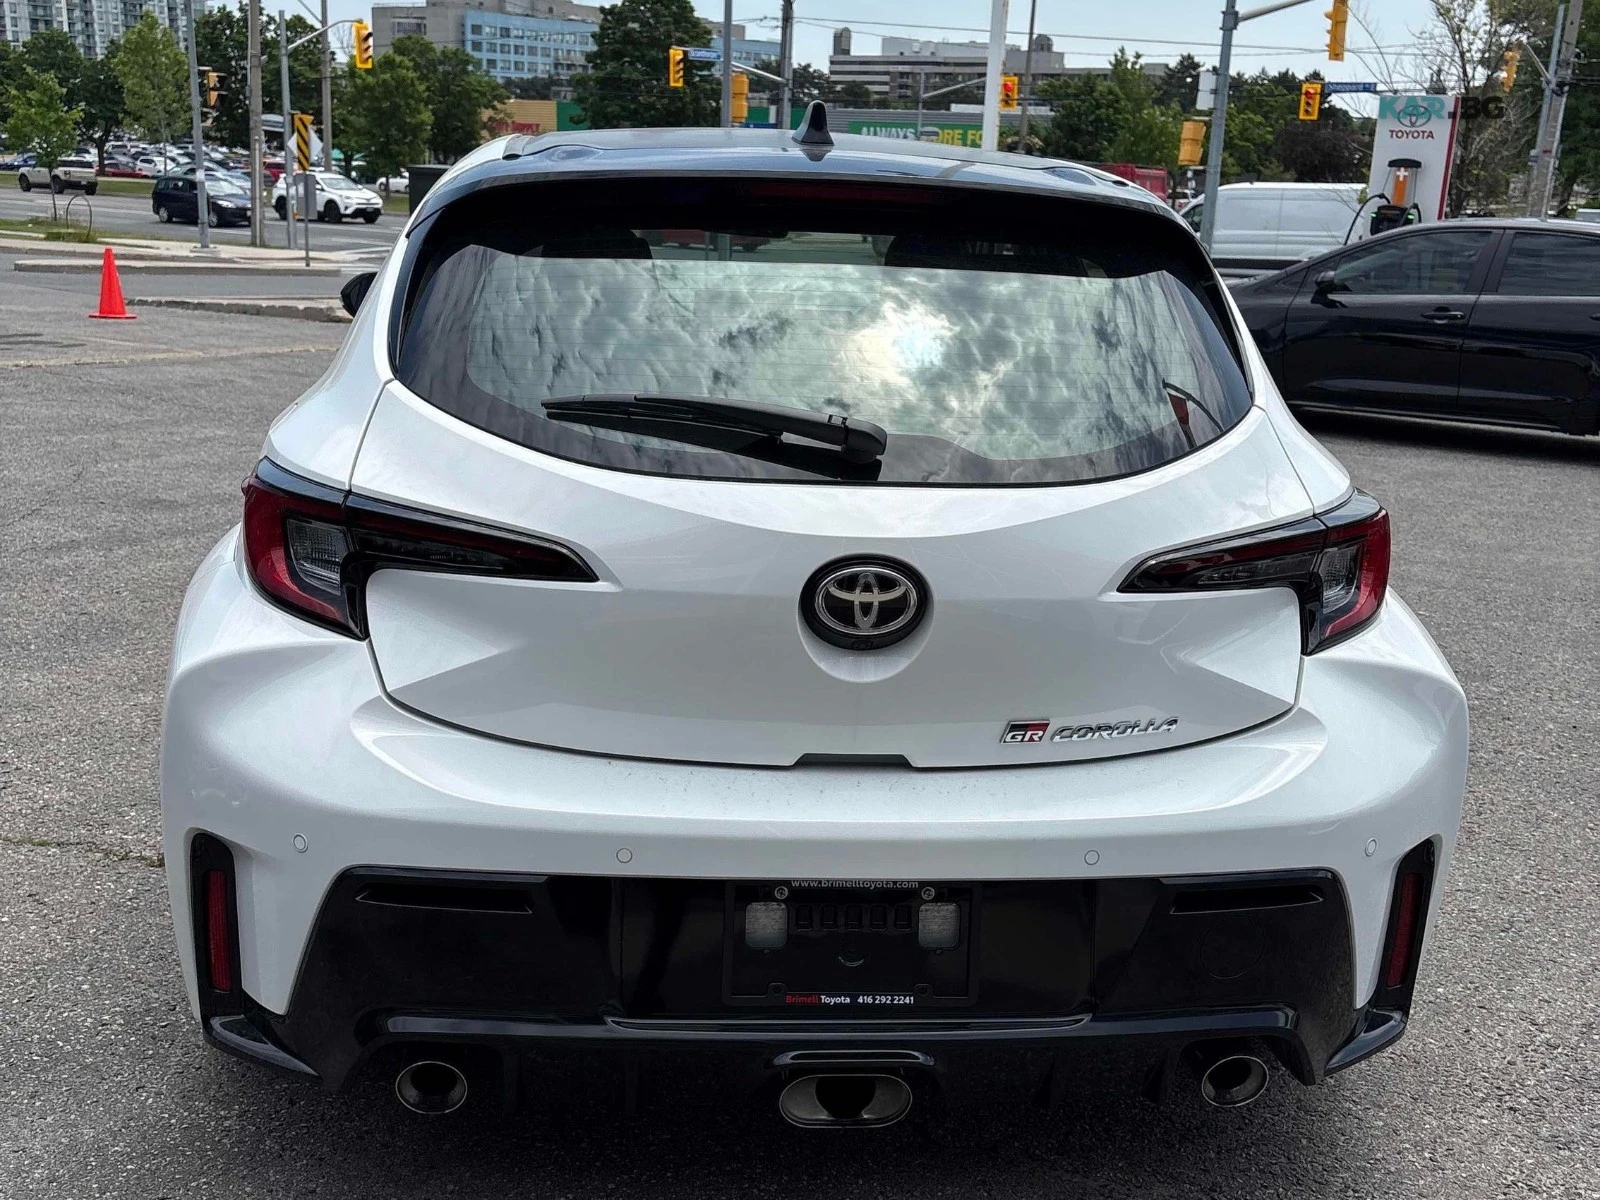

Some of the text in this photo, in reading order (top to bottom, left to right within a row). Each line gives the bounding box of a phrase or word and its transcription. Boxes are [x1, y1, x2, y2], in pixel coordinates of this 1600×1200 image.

[934, 129, 963, 146] ORE
[1389, 129, 1435, 140] TOYOTA
[1004, 717, 1179, 743] GR COROLLA
[791, 879, 919, 890] www.brimelltoyota.com
[786, 995, 914, 1005] Brimell Toyota 416 292 2241
